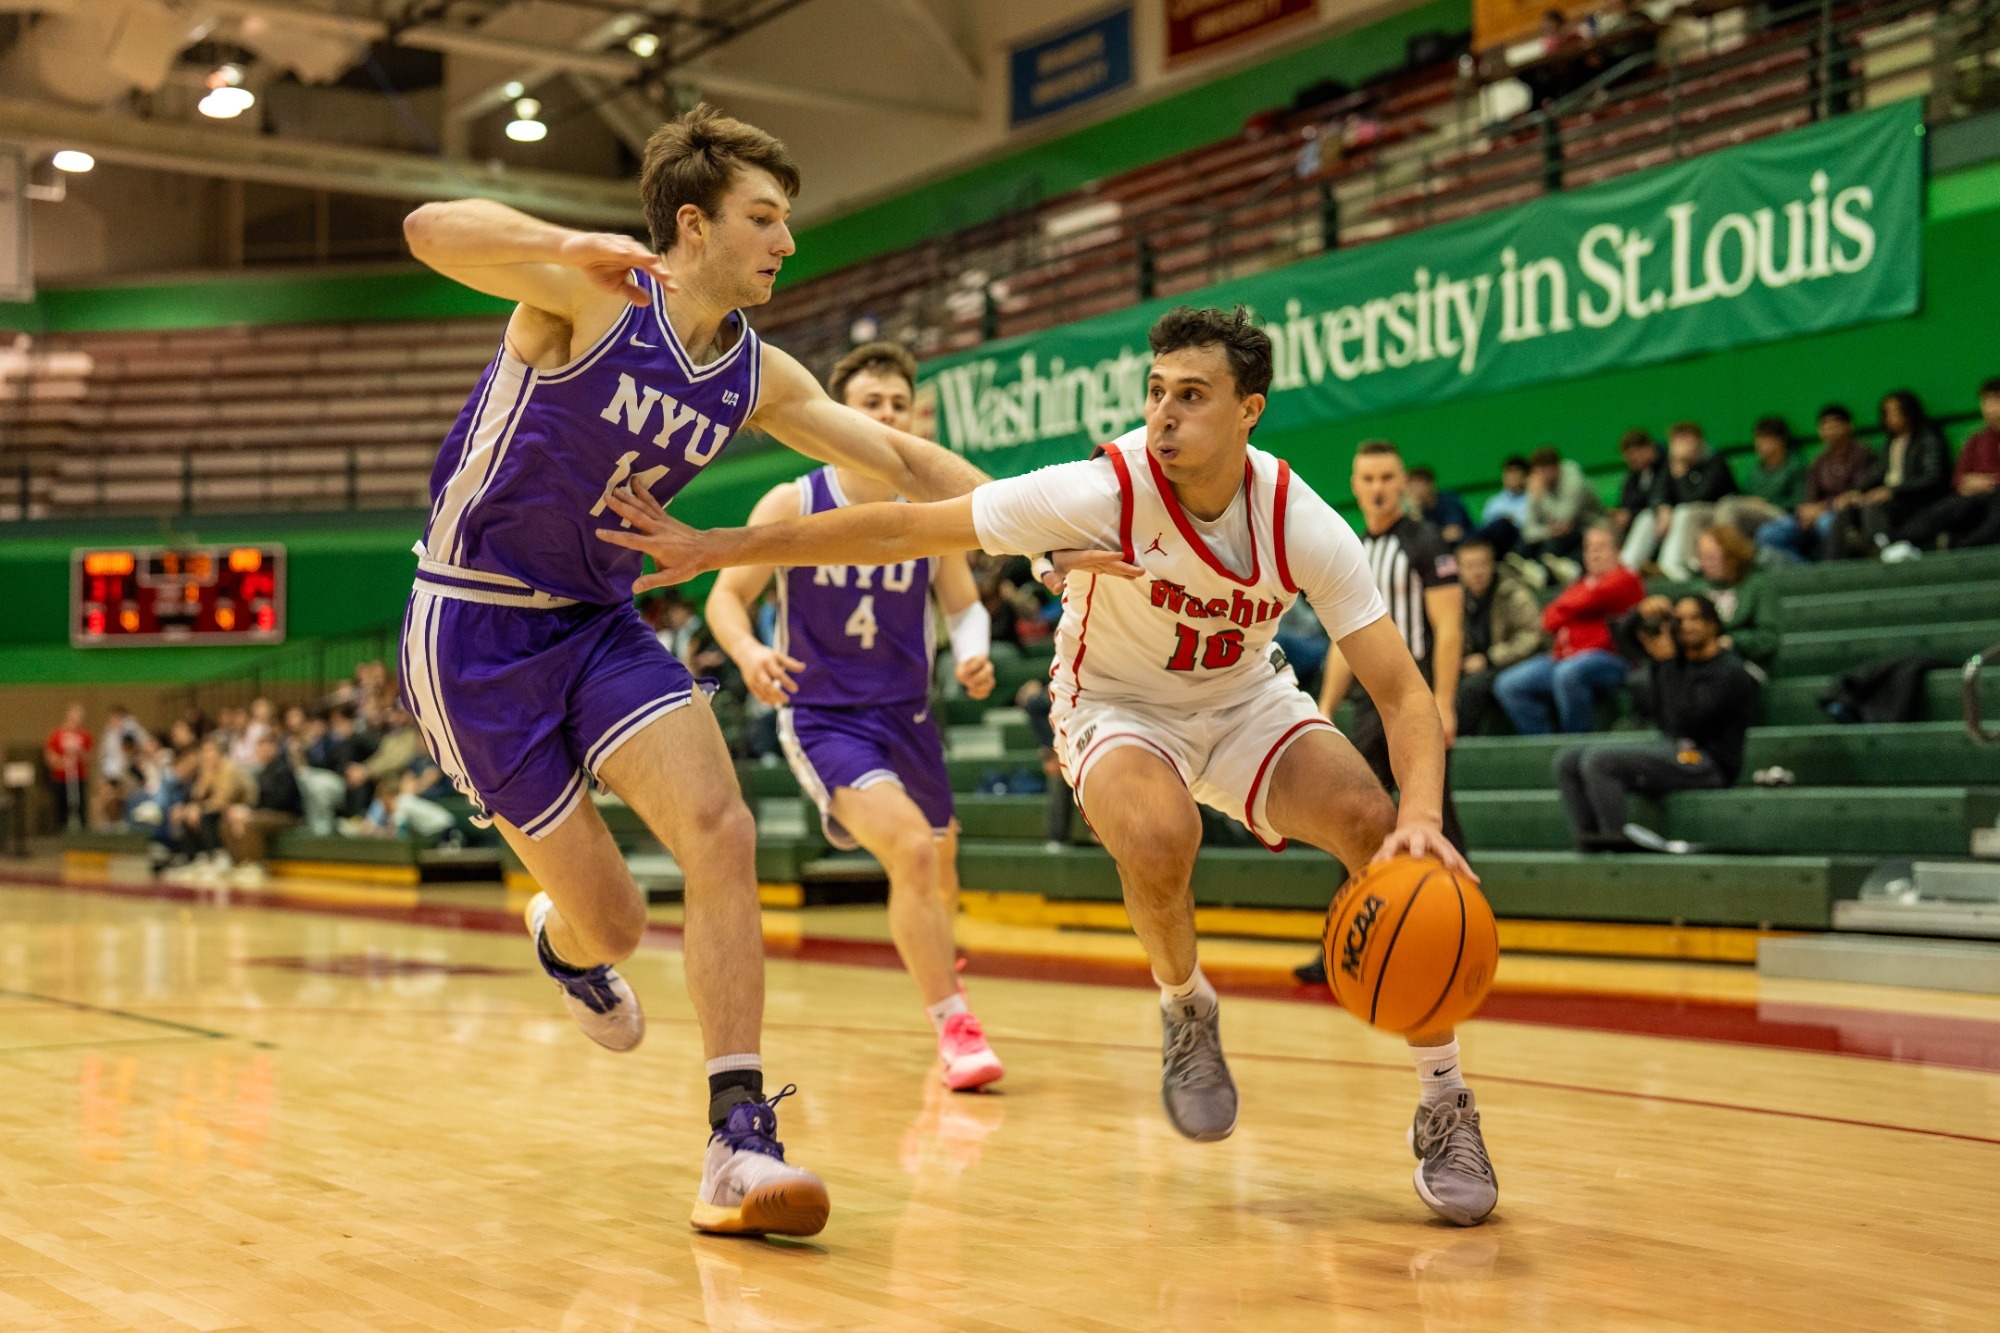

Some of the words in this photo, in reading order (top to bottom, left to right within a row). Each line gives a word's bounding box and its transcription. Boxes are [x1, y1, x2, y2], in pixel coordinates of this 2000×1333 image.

[938, 345, 1154, 452] Washingto
[1262, 265, 1493, 393] niversity
[1499, 246, 1573, 342] in
[1666, 169, 1876, 308] Louis
[600, 372, 730, 467] NYU
[845, 594, 878, 649] 4
[1341, 893, 1387, 982] NCAA
